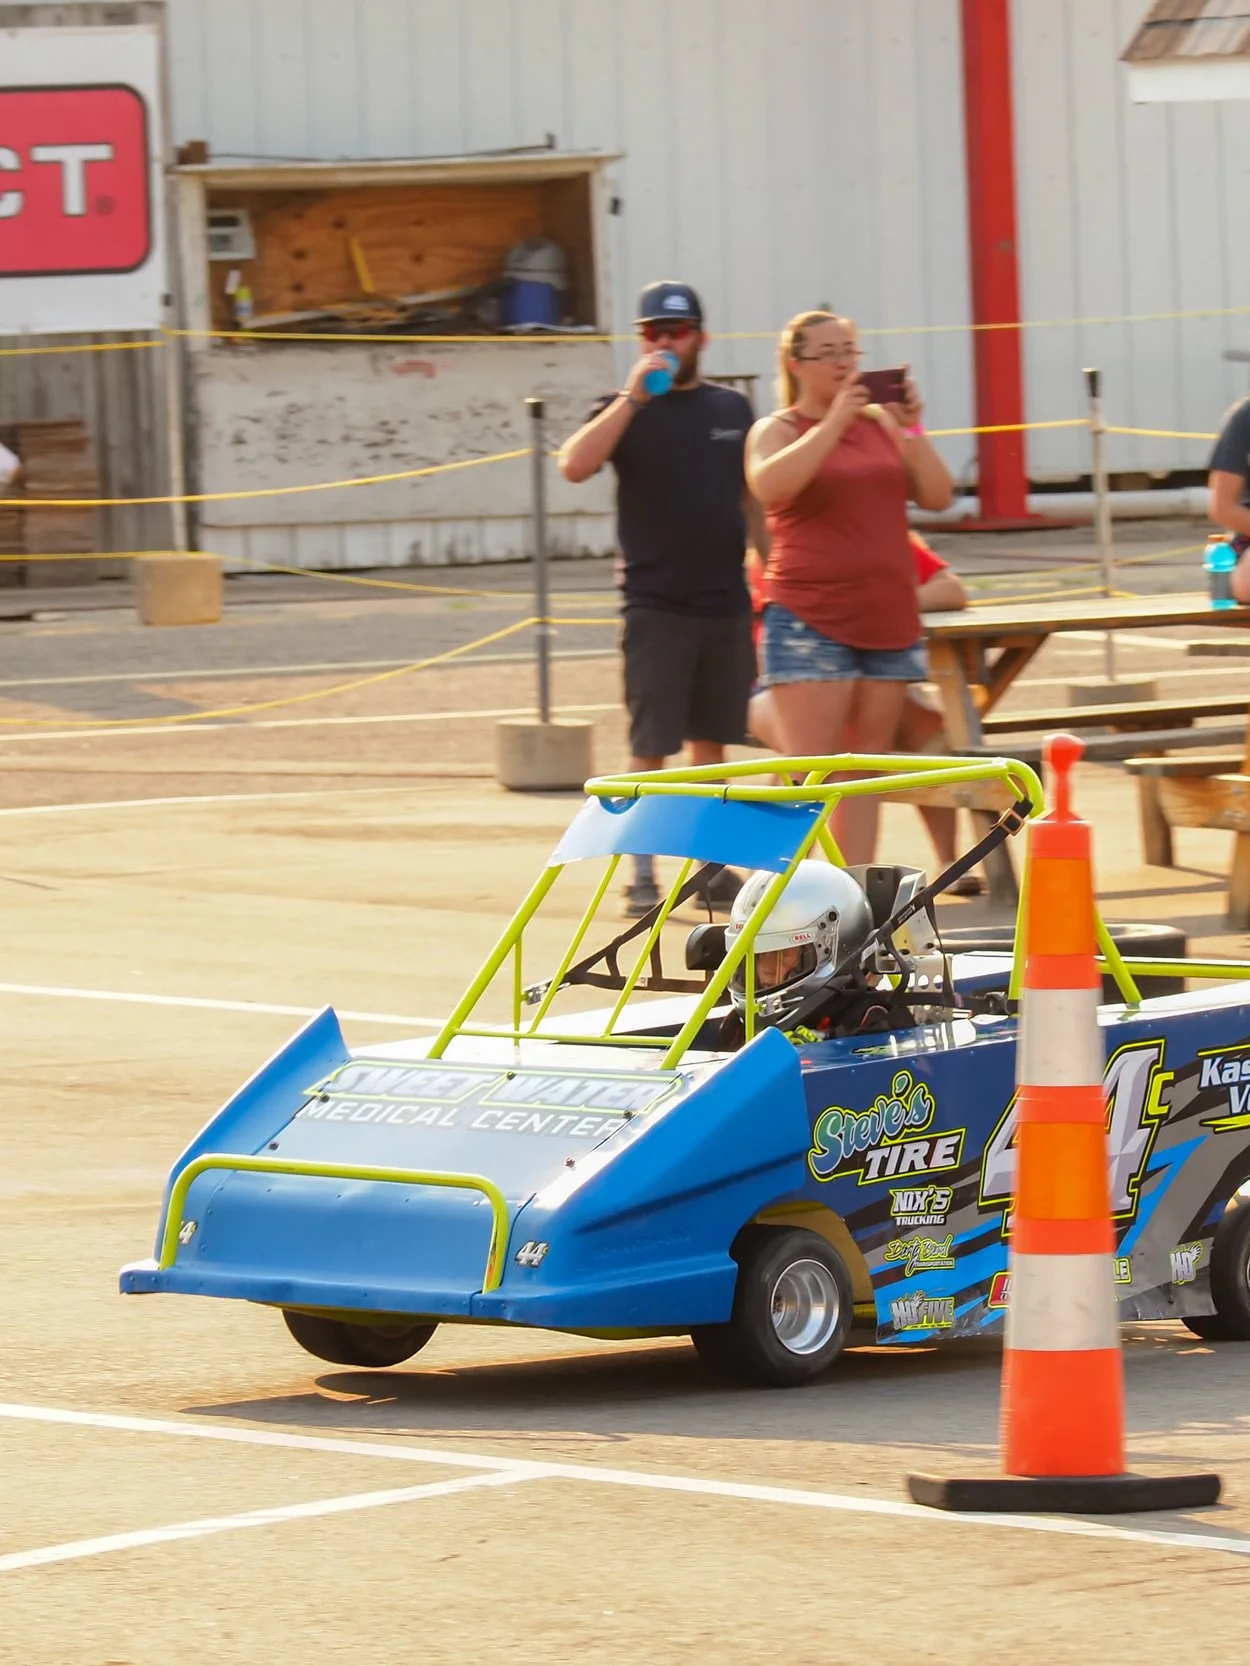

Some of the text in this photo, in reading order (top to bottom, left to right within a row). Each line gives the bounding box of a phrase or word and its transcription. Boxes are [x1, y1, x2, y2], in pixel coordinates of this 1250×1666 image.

[794, 933, 811, 941] BELL
[331, 1065, 675, 1110] SWEET WATER
[299, 1100, 626, 1138] MEDICAL CENTER
[811, 1075, 930, 1174] Steve's
[865, 1135, 961, 1180] TIRE
[893, 1187, 951, 1213] NIX'S
[894, 1214, 947, 1226] TRUCKING
